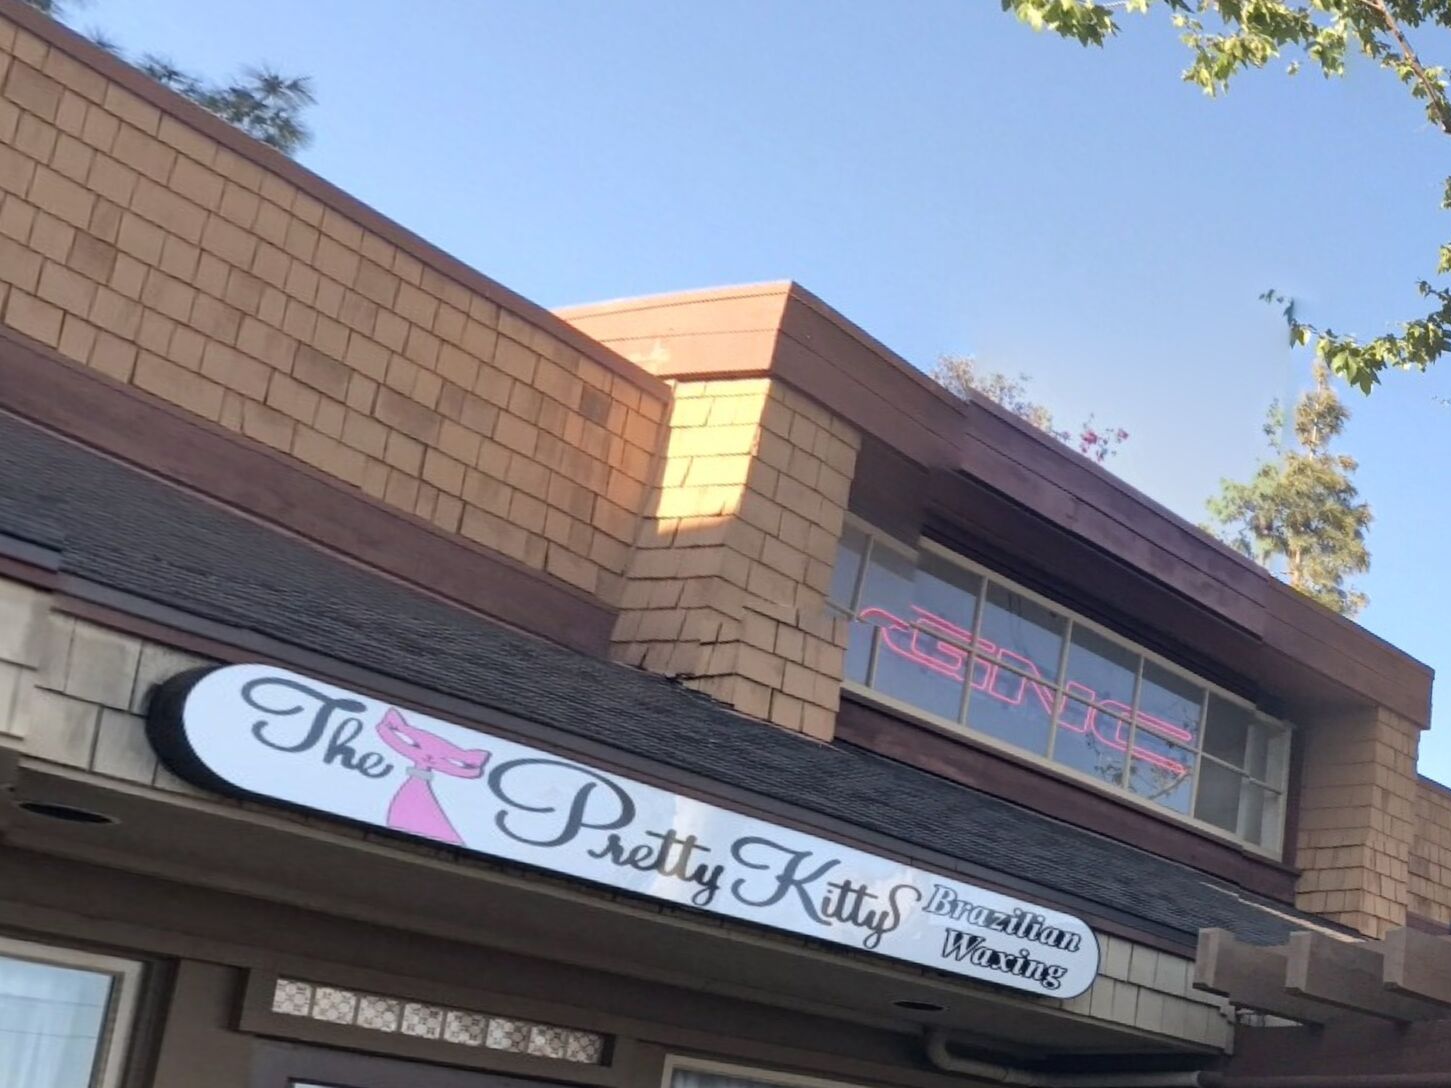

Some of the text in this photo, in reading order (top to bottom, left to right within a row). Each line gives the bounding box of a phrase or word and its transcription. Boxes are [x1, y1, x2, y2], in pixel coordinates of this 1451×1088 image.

[859, 603, 1193, 776] GNC
[239, 675, 395, 780] The
[486, 756, 726, 908] Pretty
[921, 883, 1081, 953] Brazilian
[940, 928, 1068, 991] Waxing
